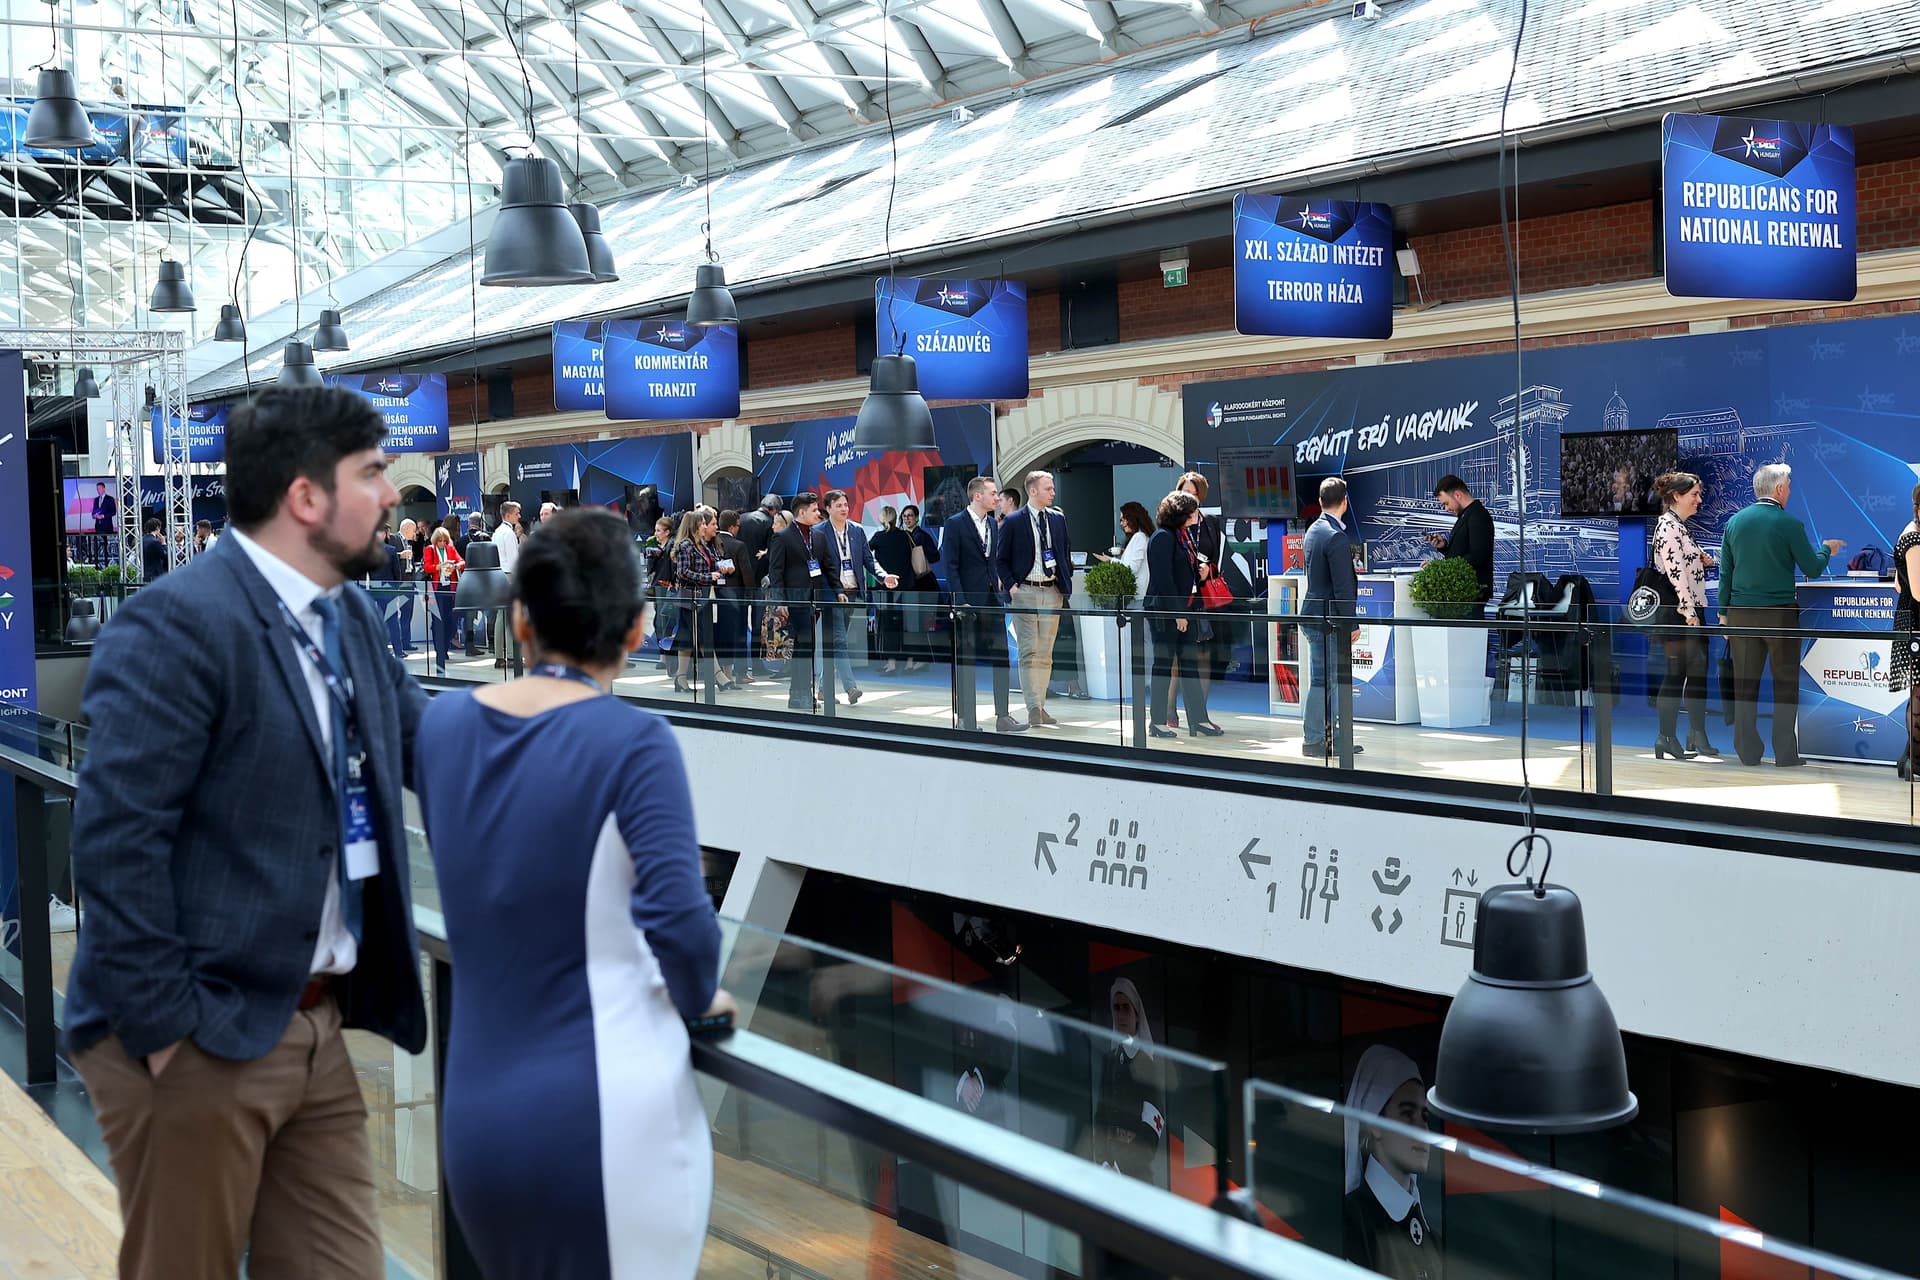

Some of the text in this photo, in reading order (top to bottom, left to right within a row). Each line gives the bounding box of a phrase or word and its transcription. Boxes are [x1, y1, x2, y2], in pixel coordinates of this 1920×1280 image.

[1683, 181, 1838, 215] REPUBLICANS FOR
[1680, 216, 1842, 249] NATIONAL RENEWAL
[1245, 237, 1384, 266] XXI. SZÁZAD INTÉZET
[1267, 278, 1363, 304] TERROR HÁZA
[916, 330, 991, 352] SZÁZADVÉG
[634, 351, 709, 370] KOMMENTÁR
[372, 397, 409, 407] FIDELITAS
[648, 383, 697, 397] TRANZIT
[179, 436, 214, 447] ZPONT
[826, 431, 837, 455] NO
[1296, 400, 1478, 464] EGYÜTT ERŐ VAGYUNK
[1832, 609, 1894, 618] NATIONAL RENEWAL
[1834, 597, 1893, 607] REPUBLICANS FOR
[1065, 812, 1081, 846] 2
[1266, 882, 1278, 913] 1
